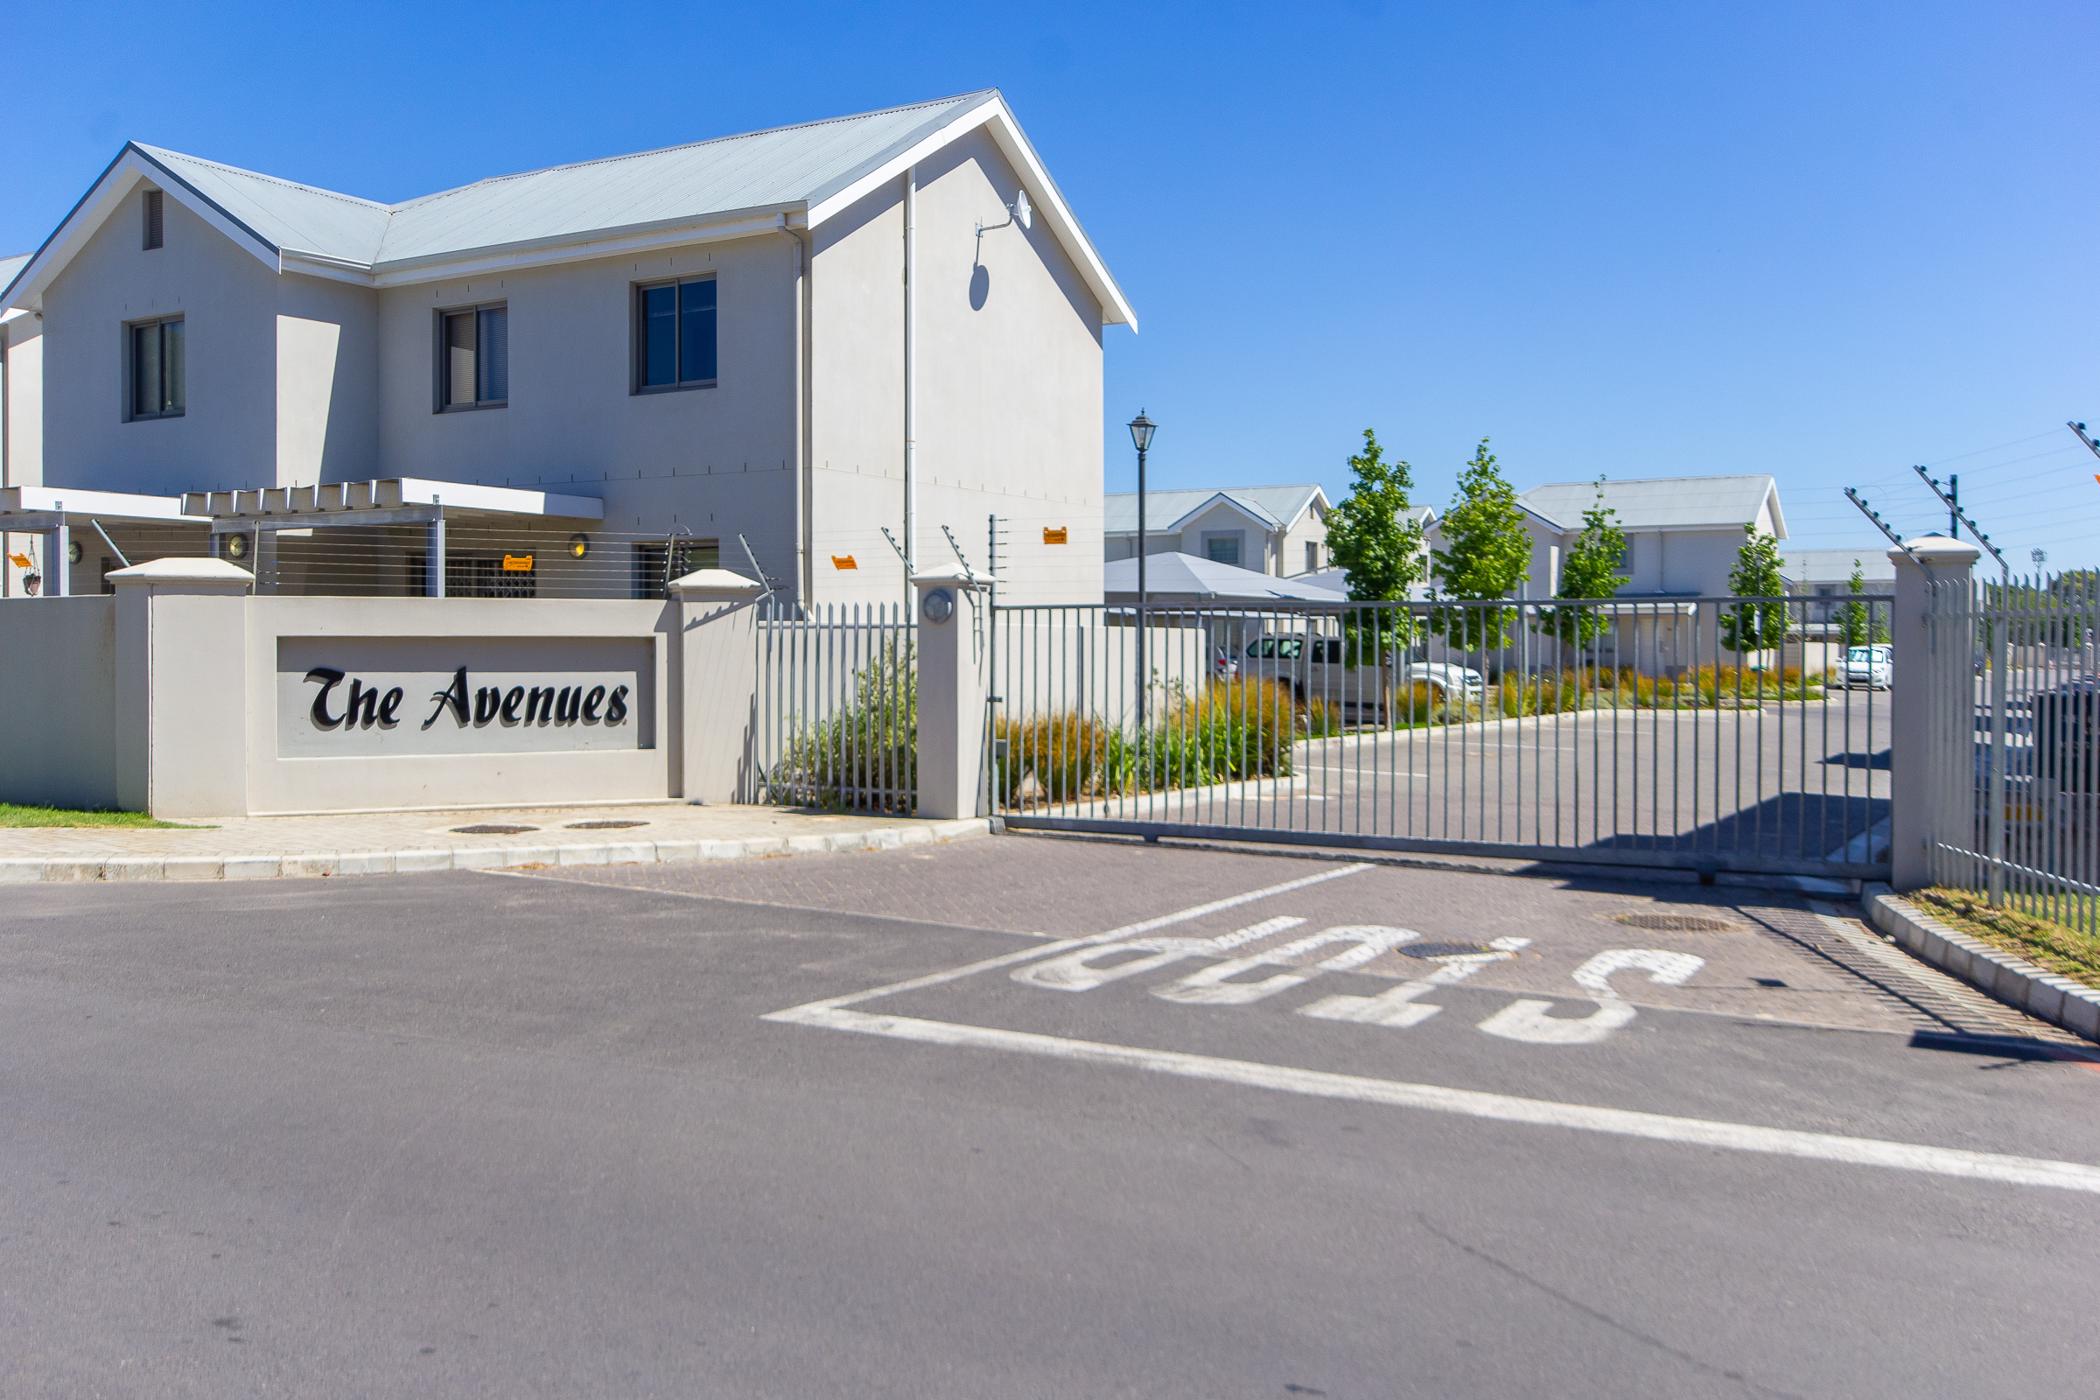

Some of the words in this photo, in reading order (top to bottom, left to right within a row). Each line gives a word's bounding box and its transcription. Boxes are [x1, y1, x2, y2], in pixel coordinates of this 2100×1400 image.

[304, 667, 403, 729] The
[421, 666, 629, 728] Avenues
[1009, 915, 1705, 1044] STOP
